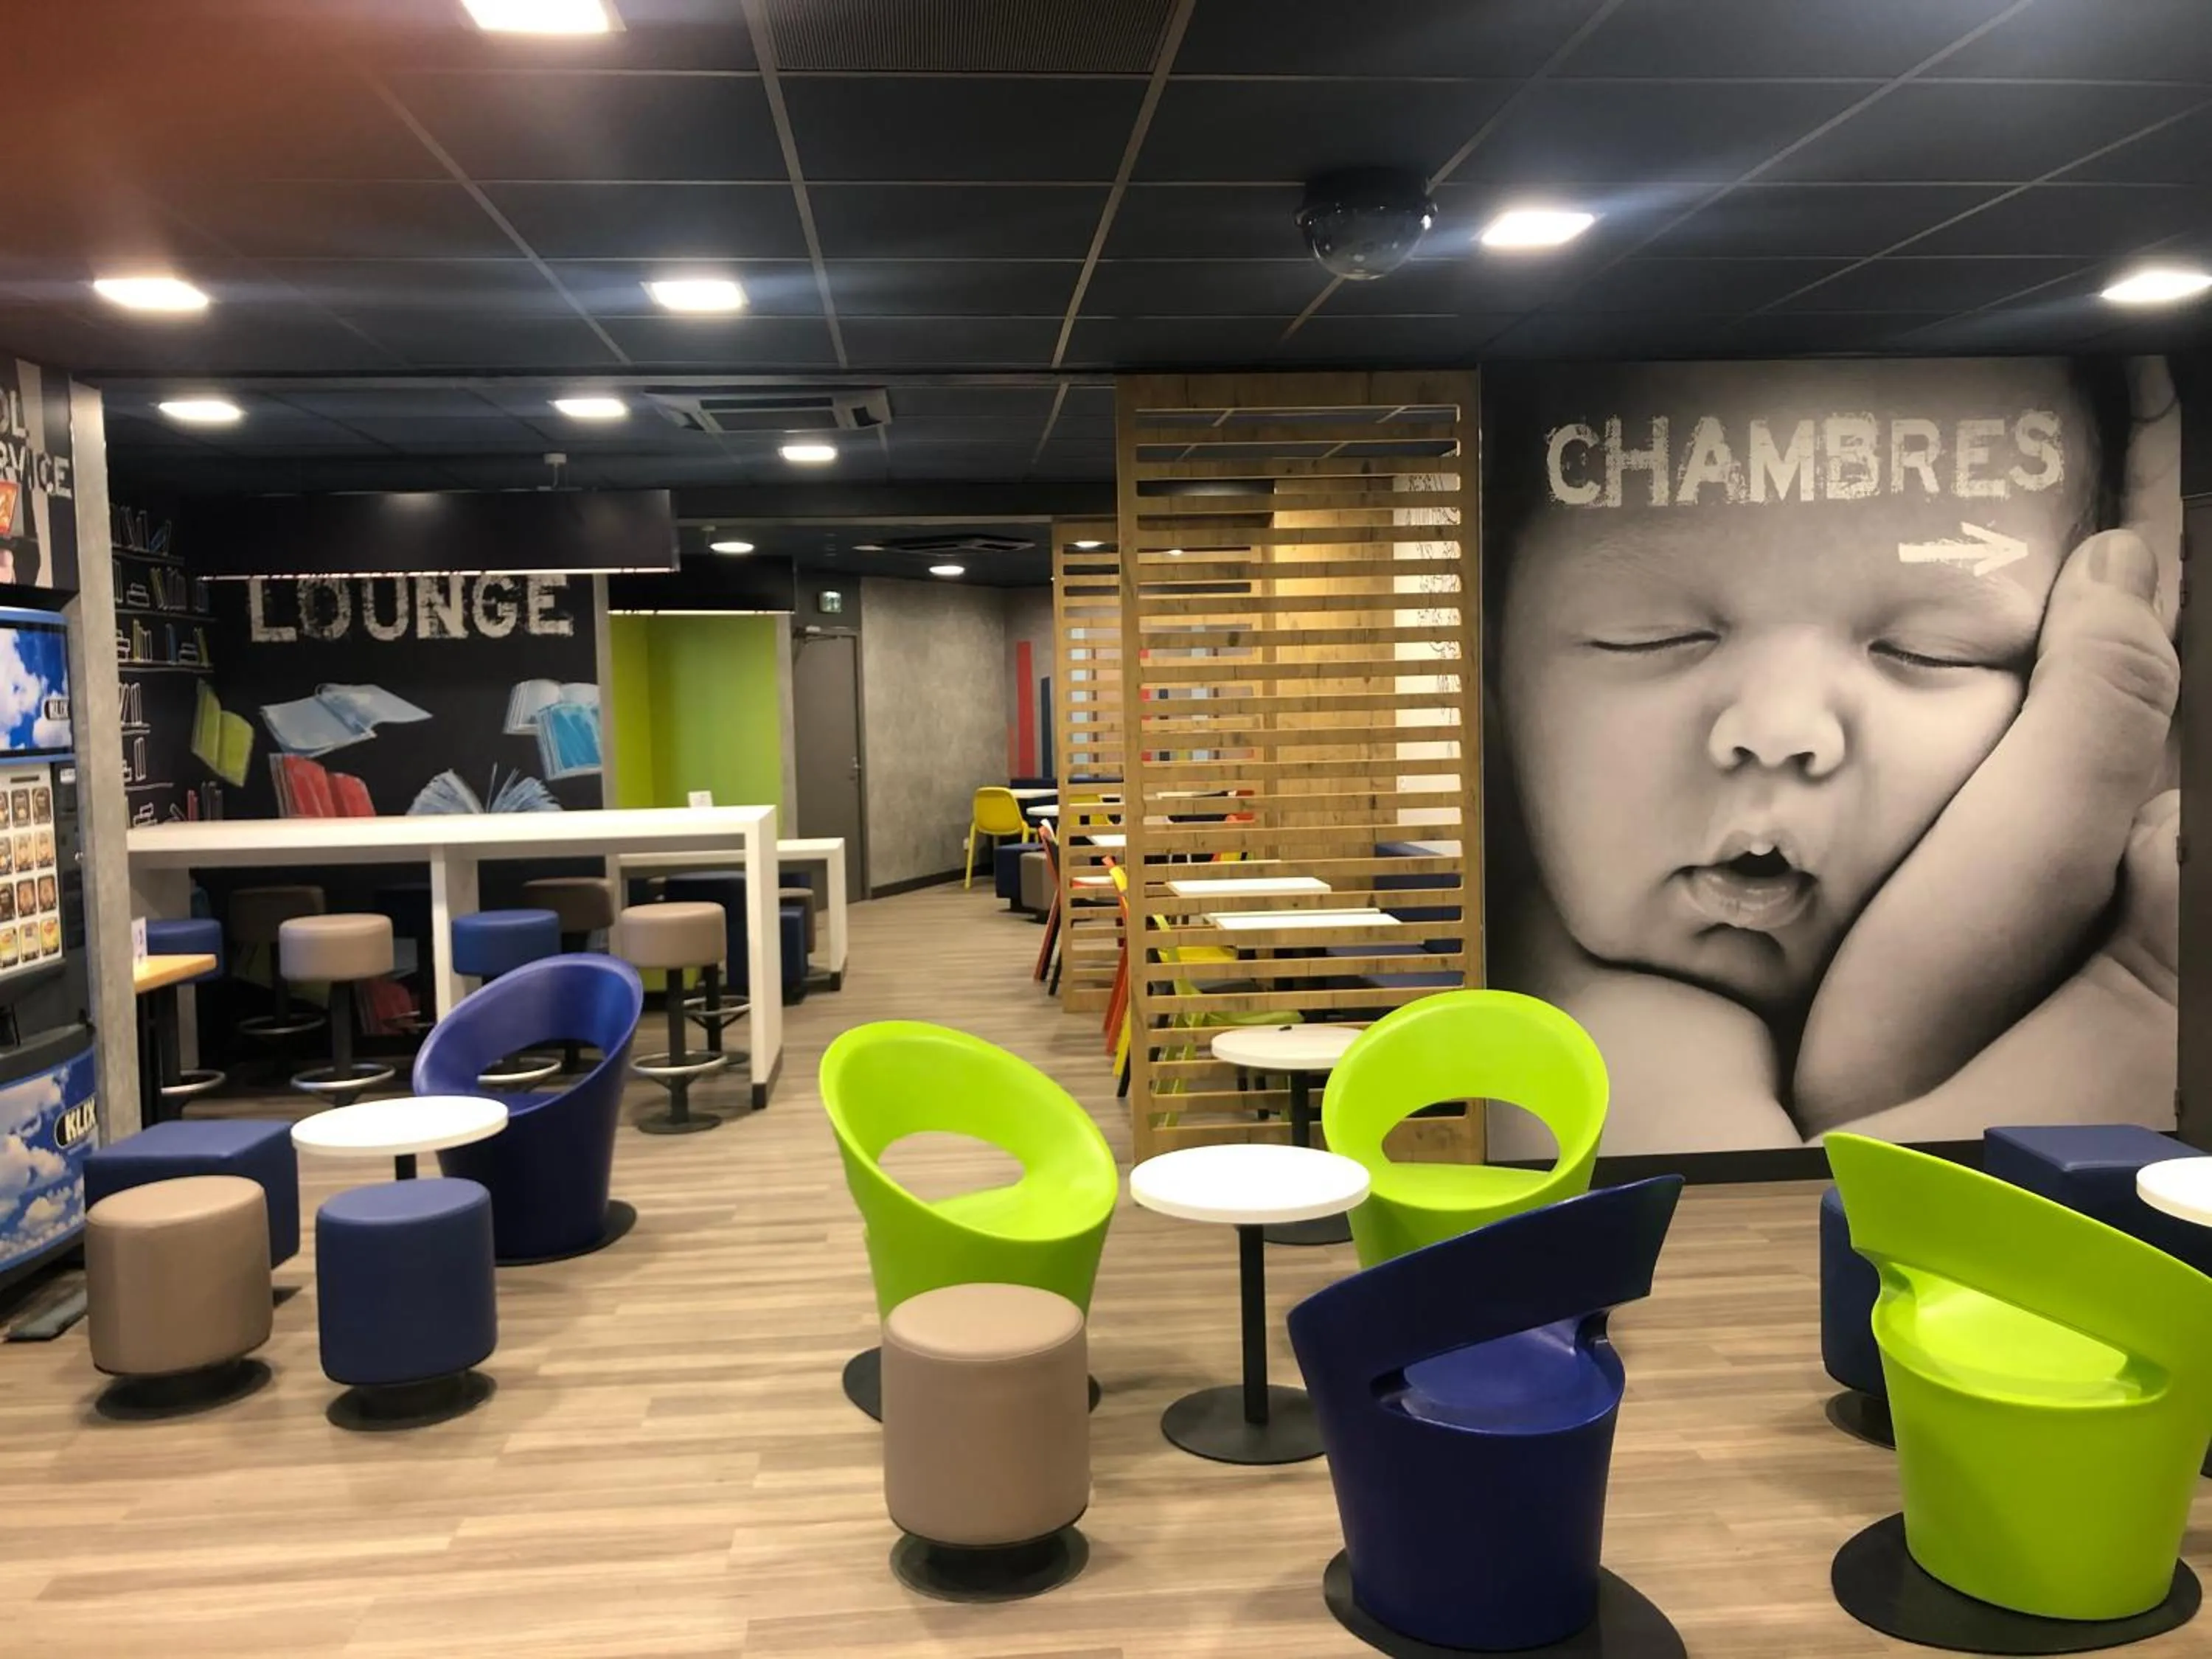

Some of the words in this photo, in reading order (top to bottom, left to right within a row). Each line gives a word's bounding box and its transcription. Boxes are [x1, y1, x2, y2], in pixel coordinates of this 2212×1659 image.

[1546, 409, 2064, 507] CHAMBRES
[248, 574, 574, 642] LOUNGE
[65, 1097, 96, 1141] KLIX
